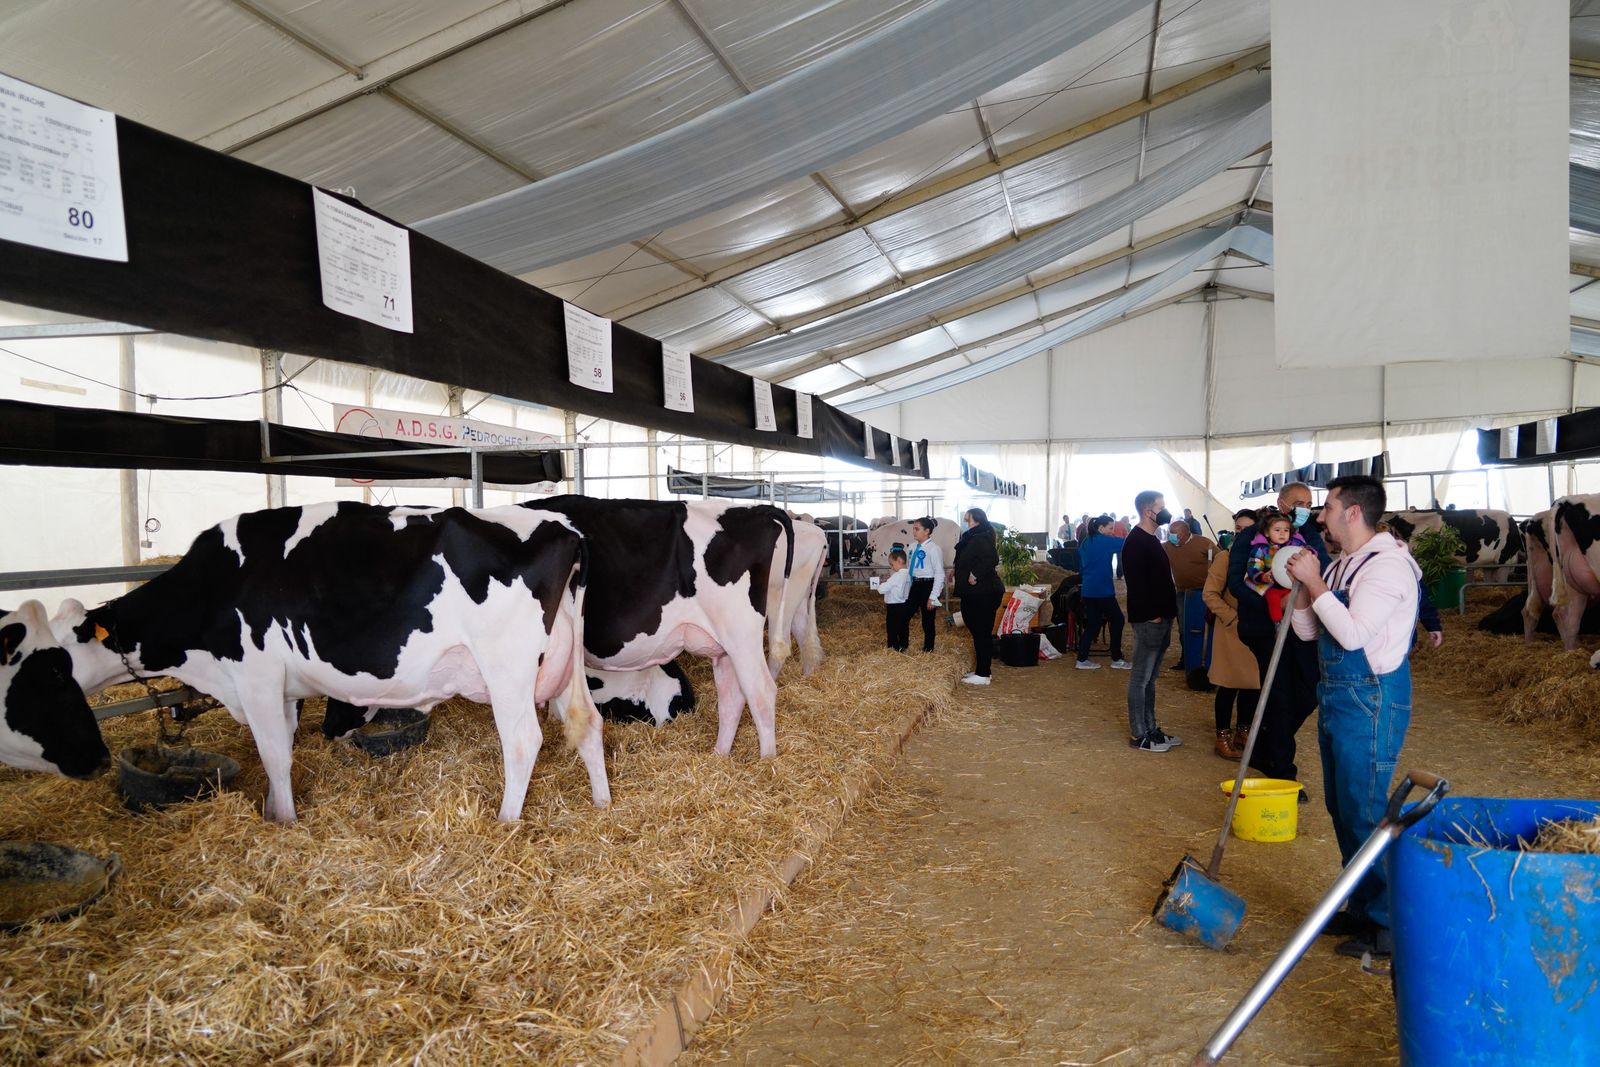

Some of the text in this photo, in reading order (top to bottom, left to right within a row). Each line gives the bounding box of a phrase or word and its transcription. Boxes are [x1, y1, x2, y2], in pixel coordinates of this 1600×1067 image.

[68, 207, 94, 229] 80
[383, 295, 395, 311] 71
[593, 367, 603, 378] 58
